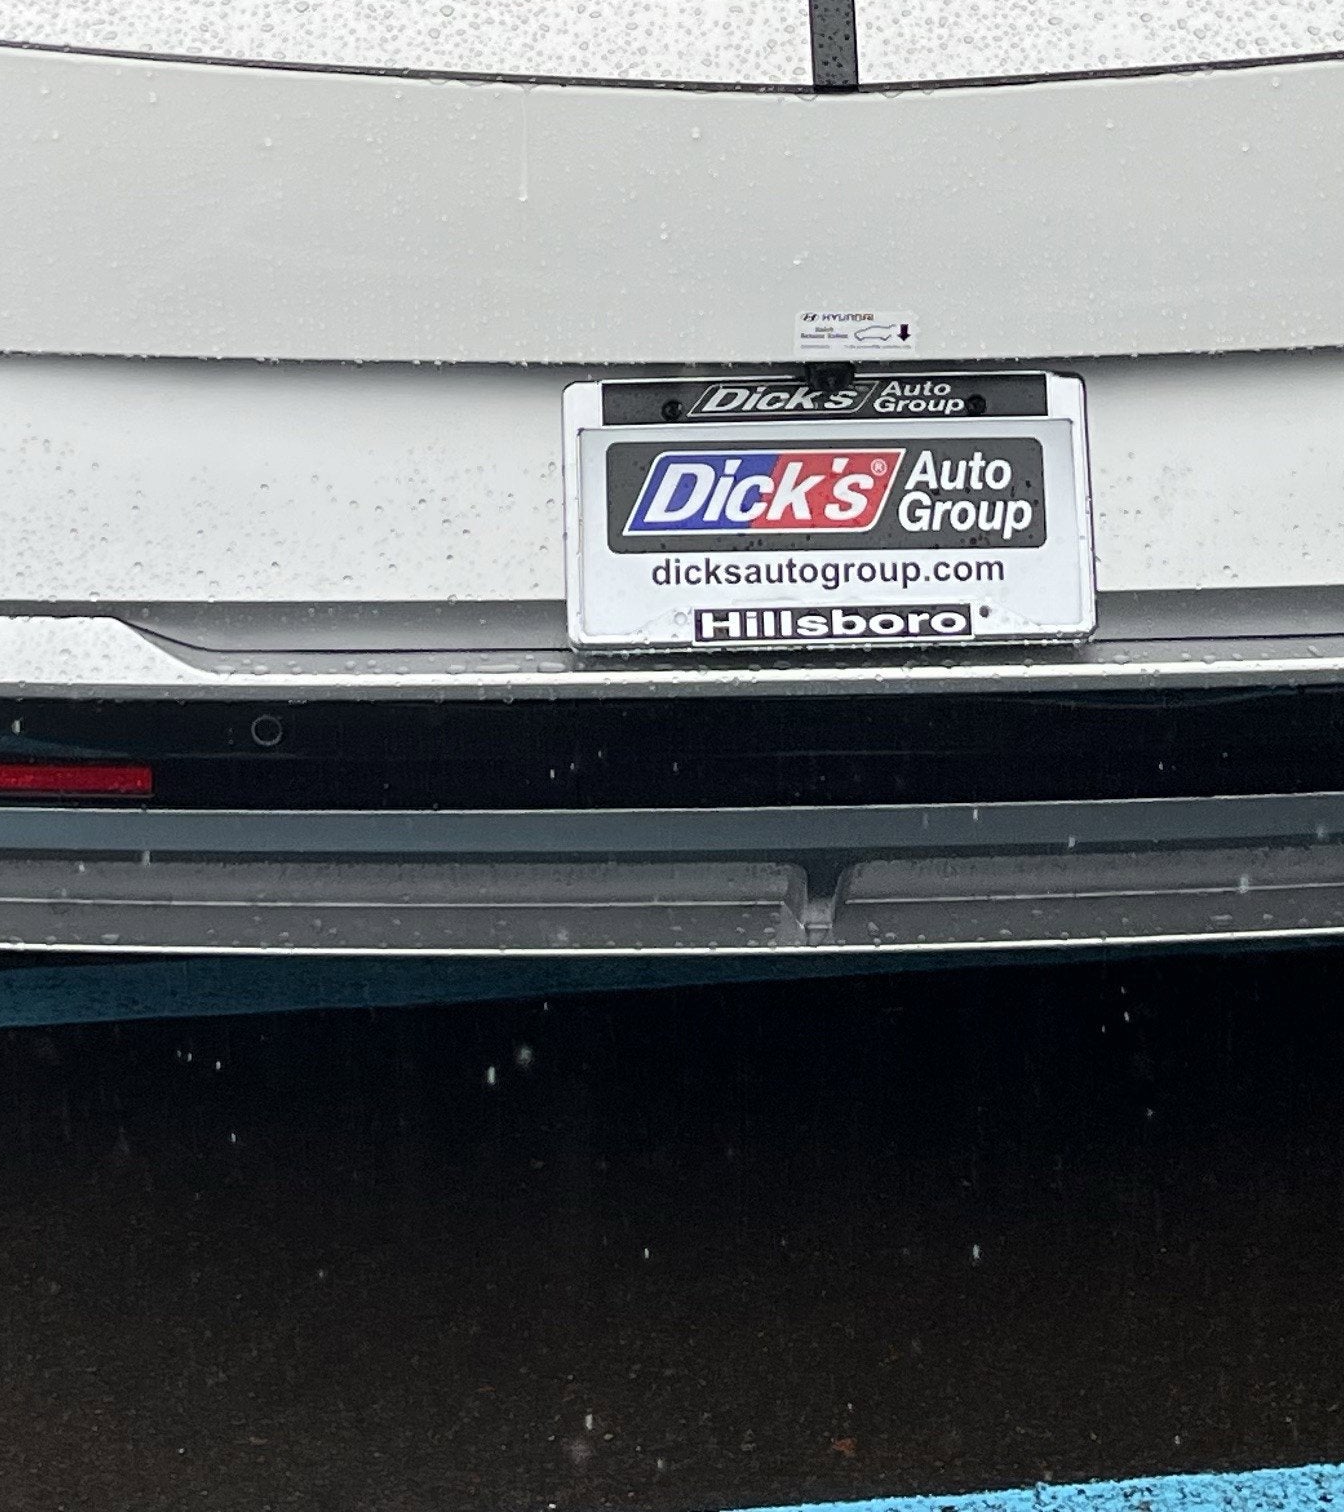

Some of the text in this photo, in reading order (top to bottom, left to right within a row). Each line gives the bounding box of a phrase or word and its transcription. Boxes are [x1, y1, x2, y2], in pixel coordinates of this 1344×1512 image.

[701, 386, 857, 412] Dicks
[881, 380, 952, 397] Auto
[873, 396, 965, 415] Group
[904, 450, 1012, 490] Auto
[898, 490, 1032, 539] Group
[652, 557, 1005, 589] dicksautogroup.com
[701, 604, 967, 638] Hillsboro
